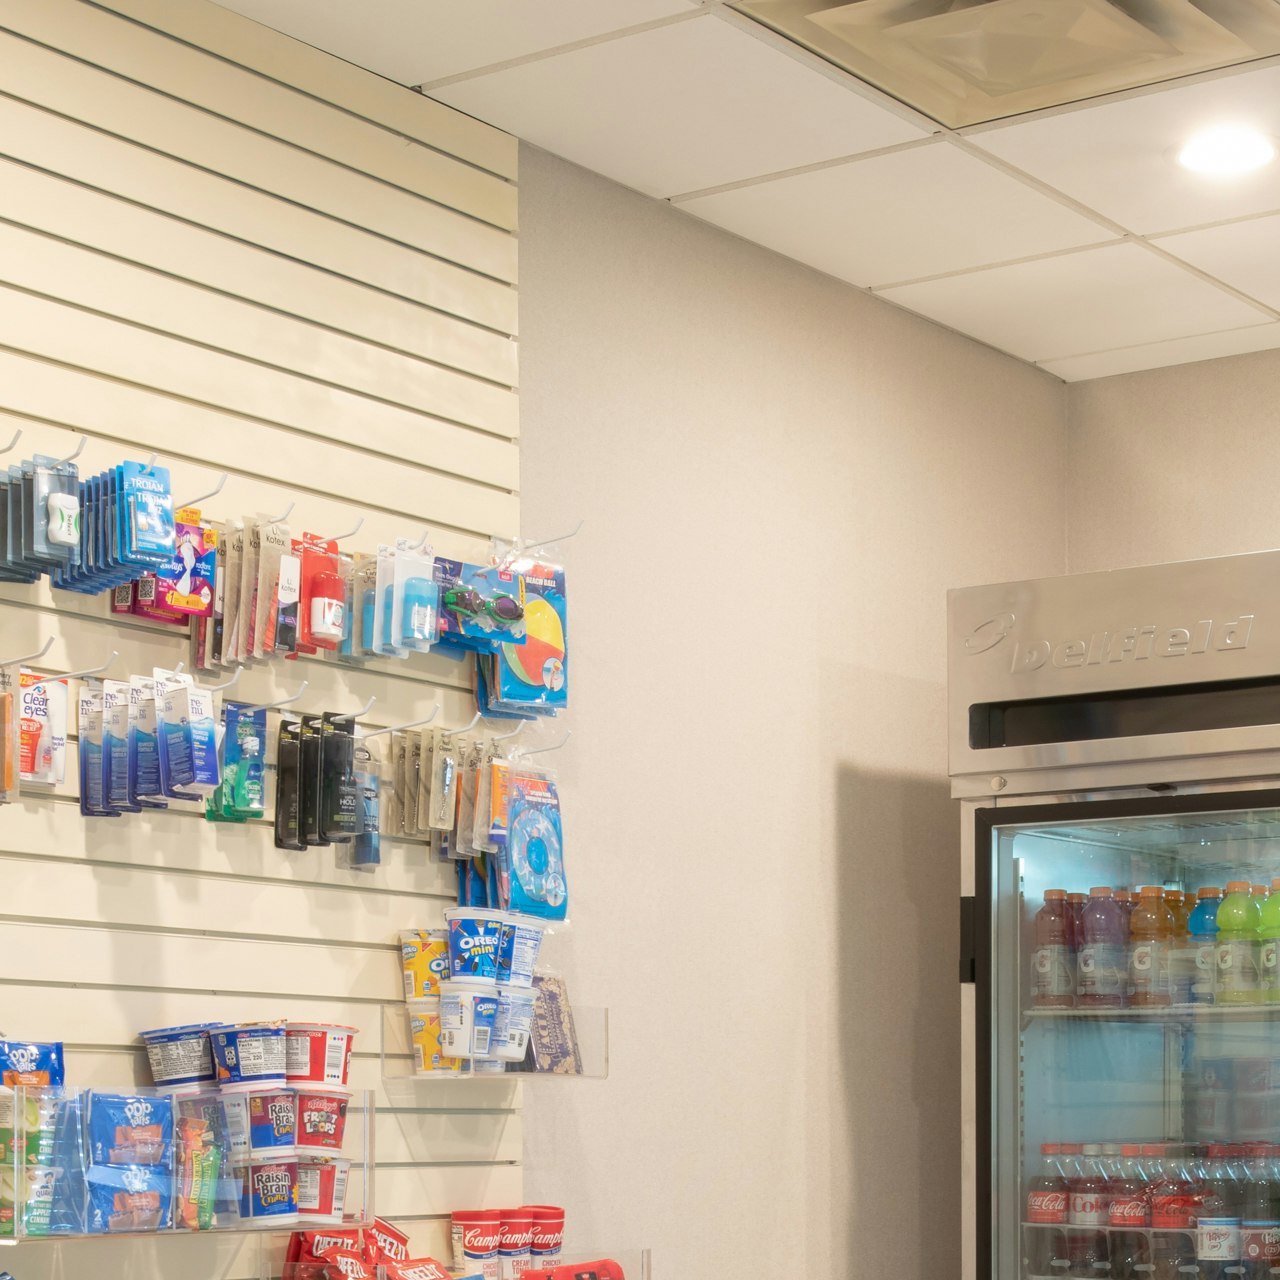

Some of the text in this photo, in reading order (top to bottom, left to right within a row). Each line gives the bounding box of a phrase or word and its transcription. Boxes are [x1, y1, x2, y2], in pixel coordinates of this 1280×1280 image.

[266, 536, 286, 547] Kotex
[1011, 615, 1254, 673] Delfield
[23, 693, 50, 707] Clear
[24, 705, 48, 717] eyes
[459, 936, 498, 949] OREO
[470, 944, 495, 957] mini
[255, 1173, 290, 1185] Raisin
[260, 1183, 287, 1195] Bran
